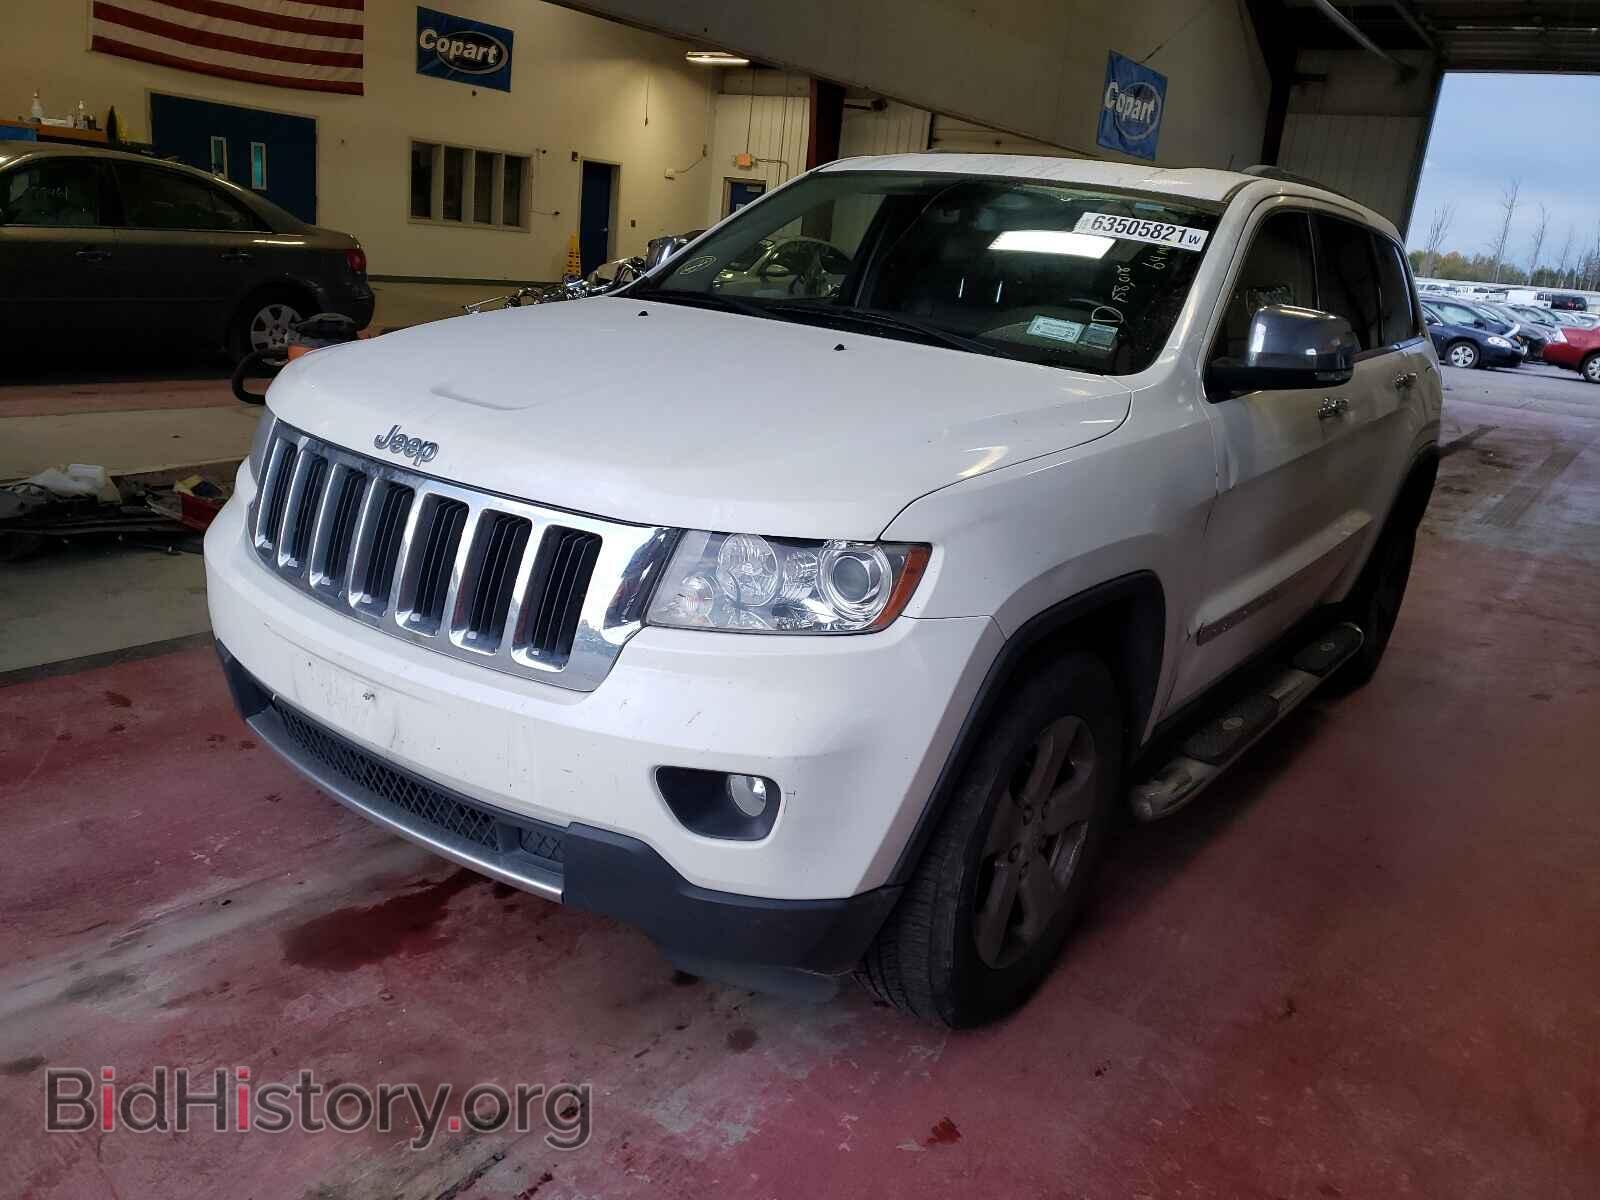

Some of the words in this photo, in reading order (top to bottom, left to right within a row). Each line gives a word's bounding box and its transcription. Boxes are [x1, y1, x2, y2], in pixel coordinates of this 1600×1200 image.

[420, 28, 497, 65] Copart
[1104, 81, 1155, 124] Copart
[1090, 215, 1188, 243] 63505821
[374, 424, 440, 467] Jeep
